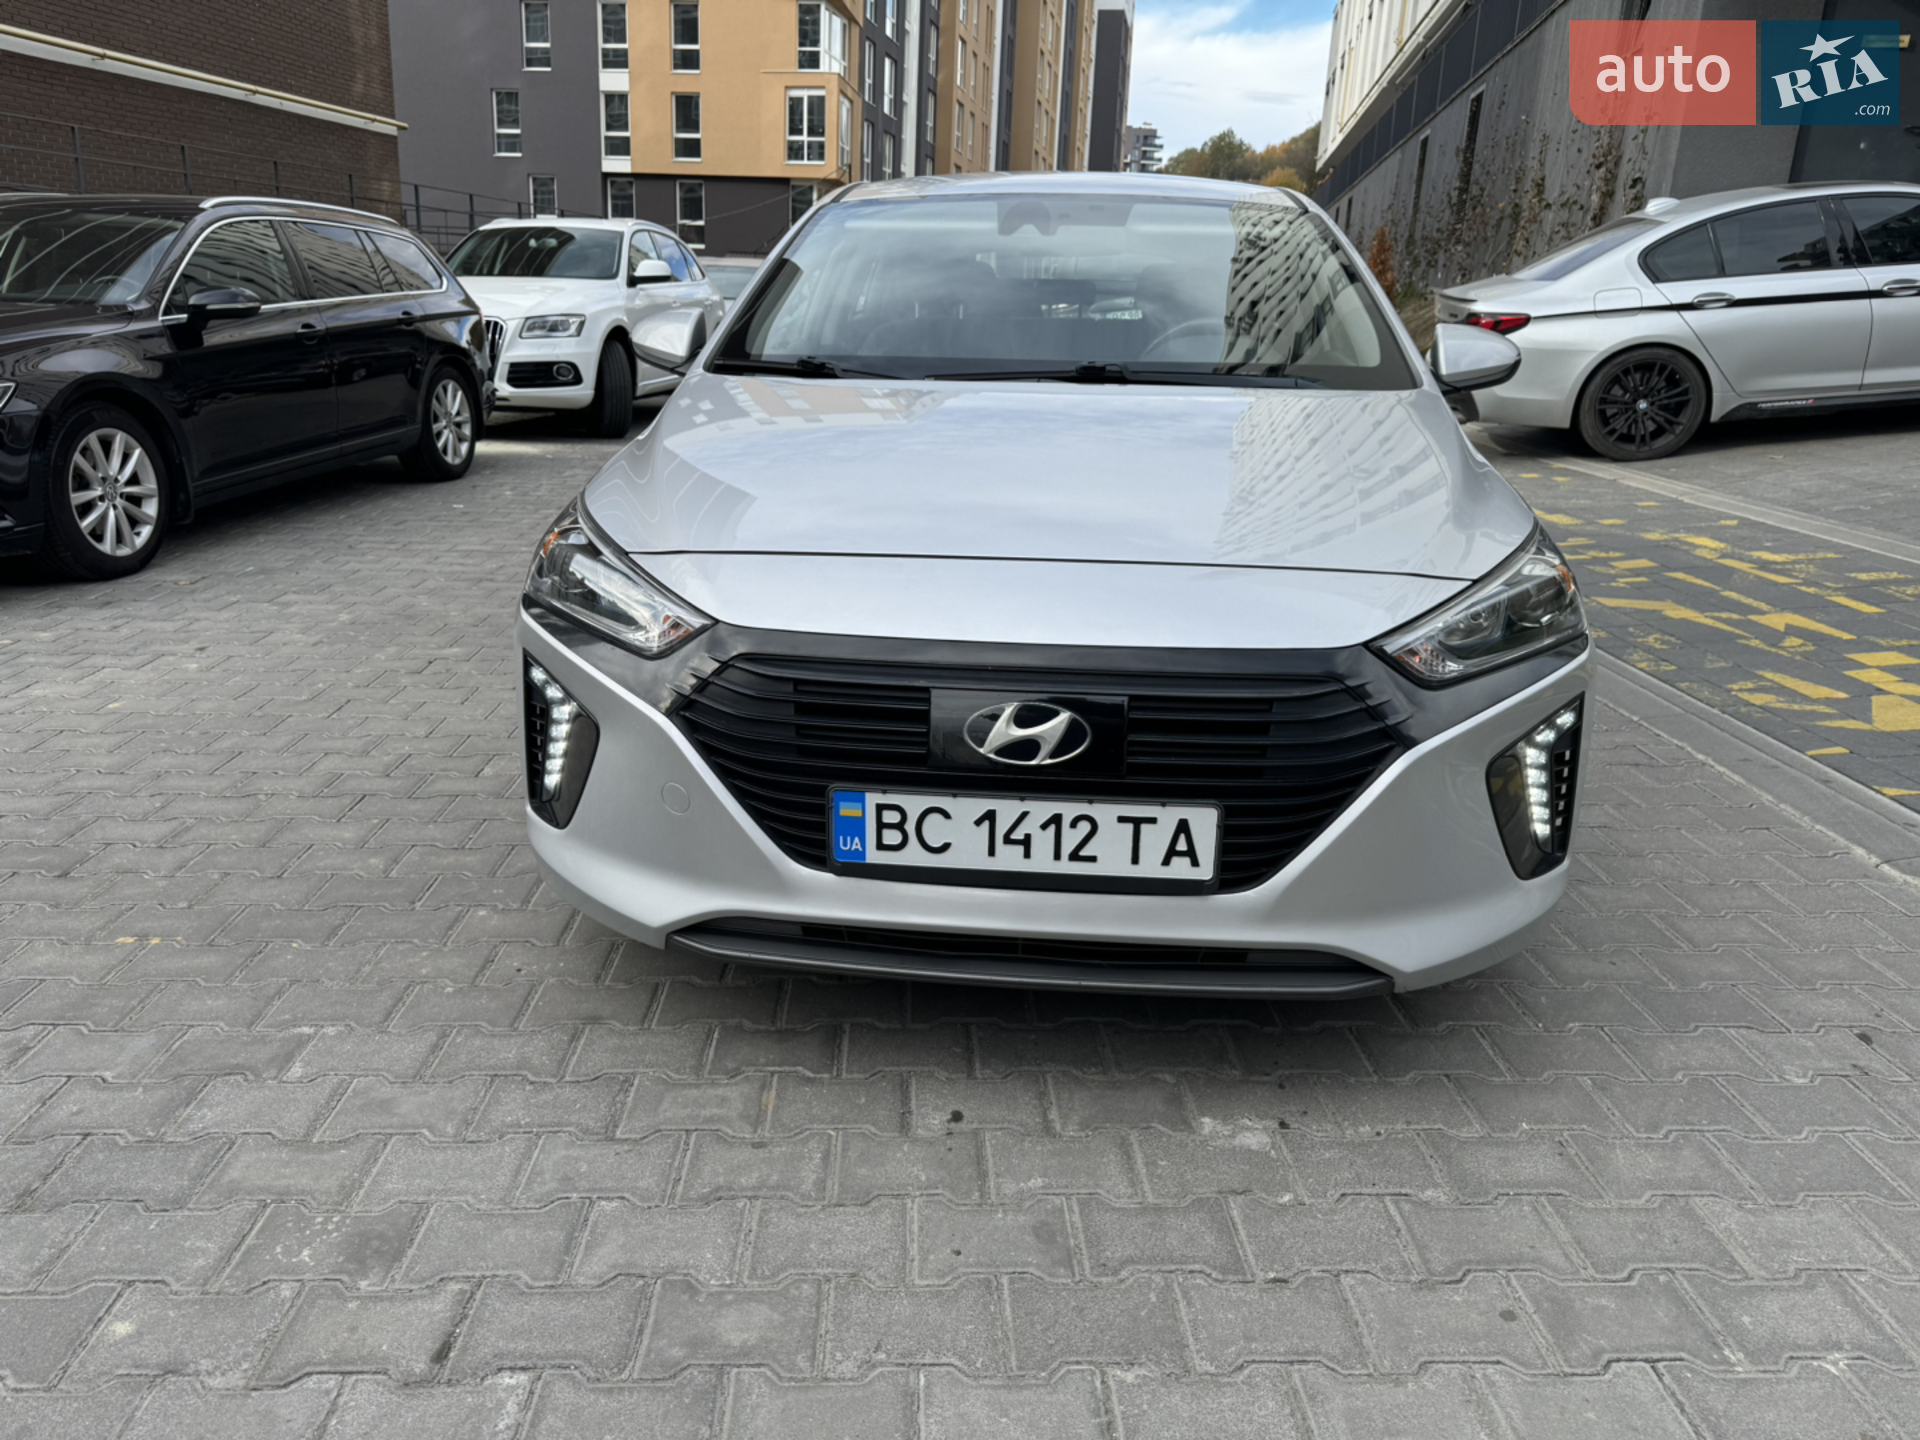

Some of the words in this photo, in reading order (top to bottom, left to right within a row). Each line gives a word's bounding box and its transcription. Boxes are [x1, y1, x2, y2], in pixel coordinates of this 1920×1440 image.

[839, 835, 864, 852] UA
[875, 802, 953, 855] BC
[973, 808, 1100, 863] 1412
[1116, 815, 1201, 868] TA
